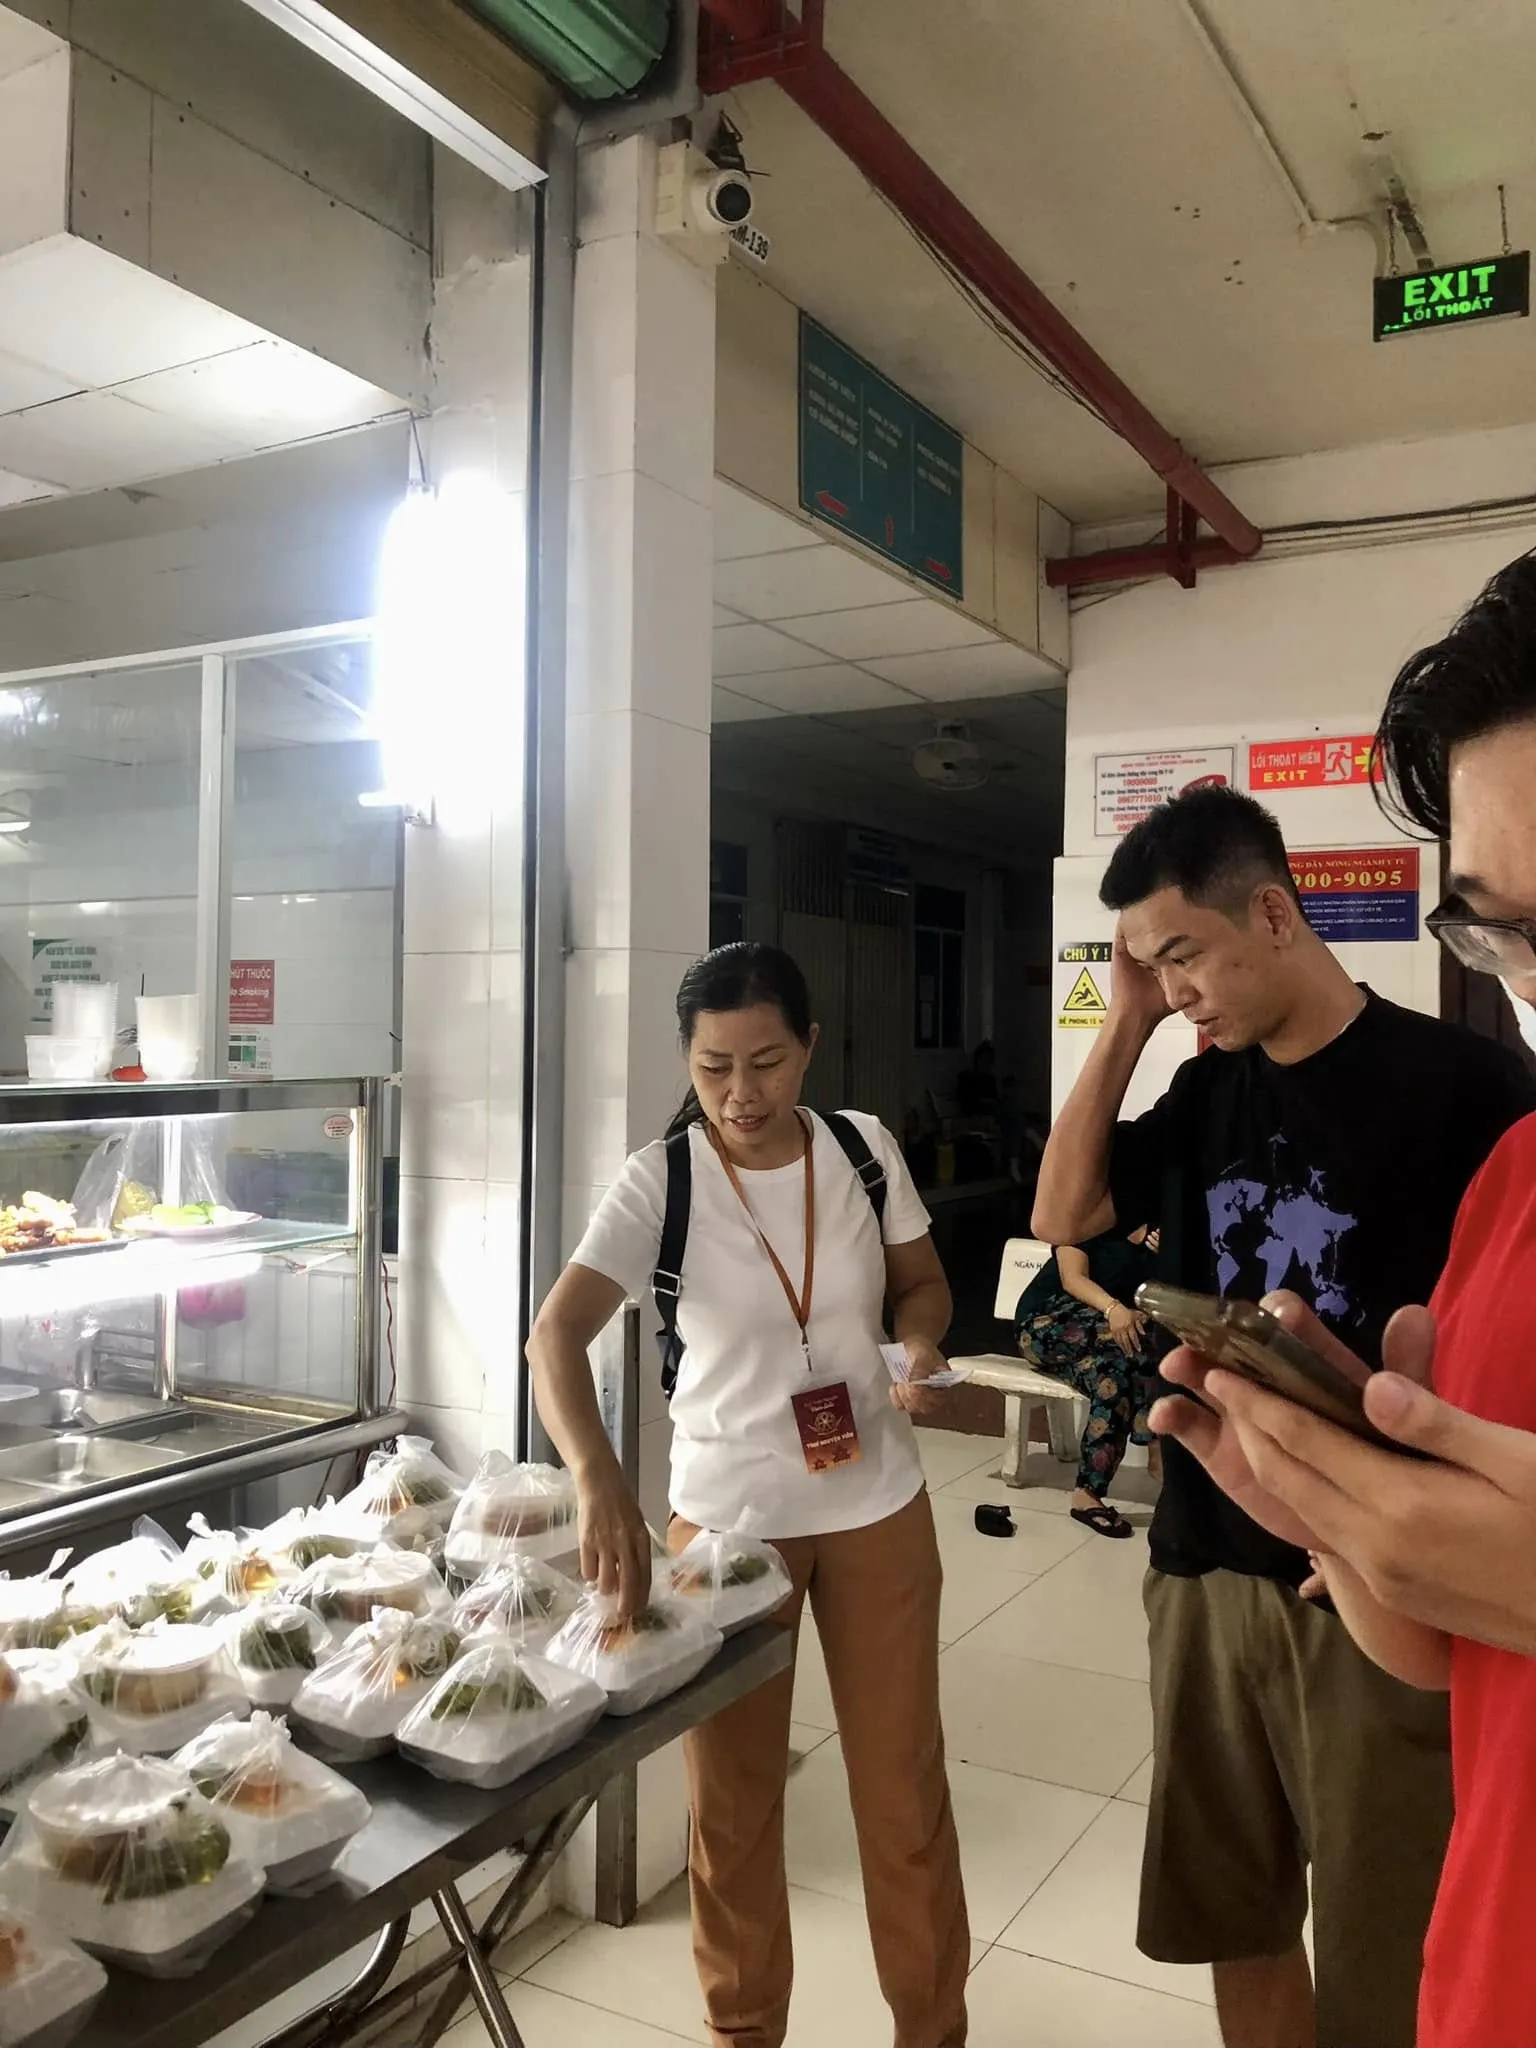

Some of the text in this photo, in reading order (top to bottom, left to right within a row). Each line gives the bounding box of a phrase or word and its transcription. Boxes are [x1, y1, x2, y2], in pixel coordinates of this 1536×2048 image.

[1404, 265, 1496, 306] EXIT
[1403, 296, 1493, 323] LỐI THOÁT
[1264, 770, 1308, 782] EXIT
[1292, 870, 1402, 888] 900-9095
[1063, 944, 1109, 961] CHÚ Ý !
